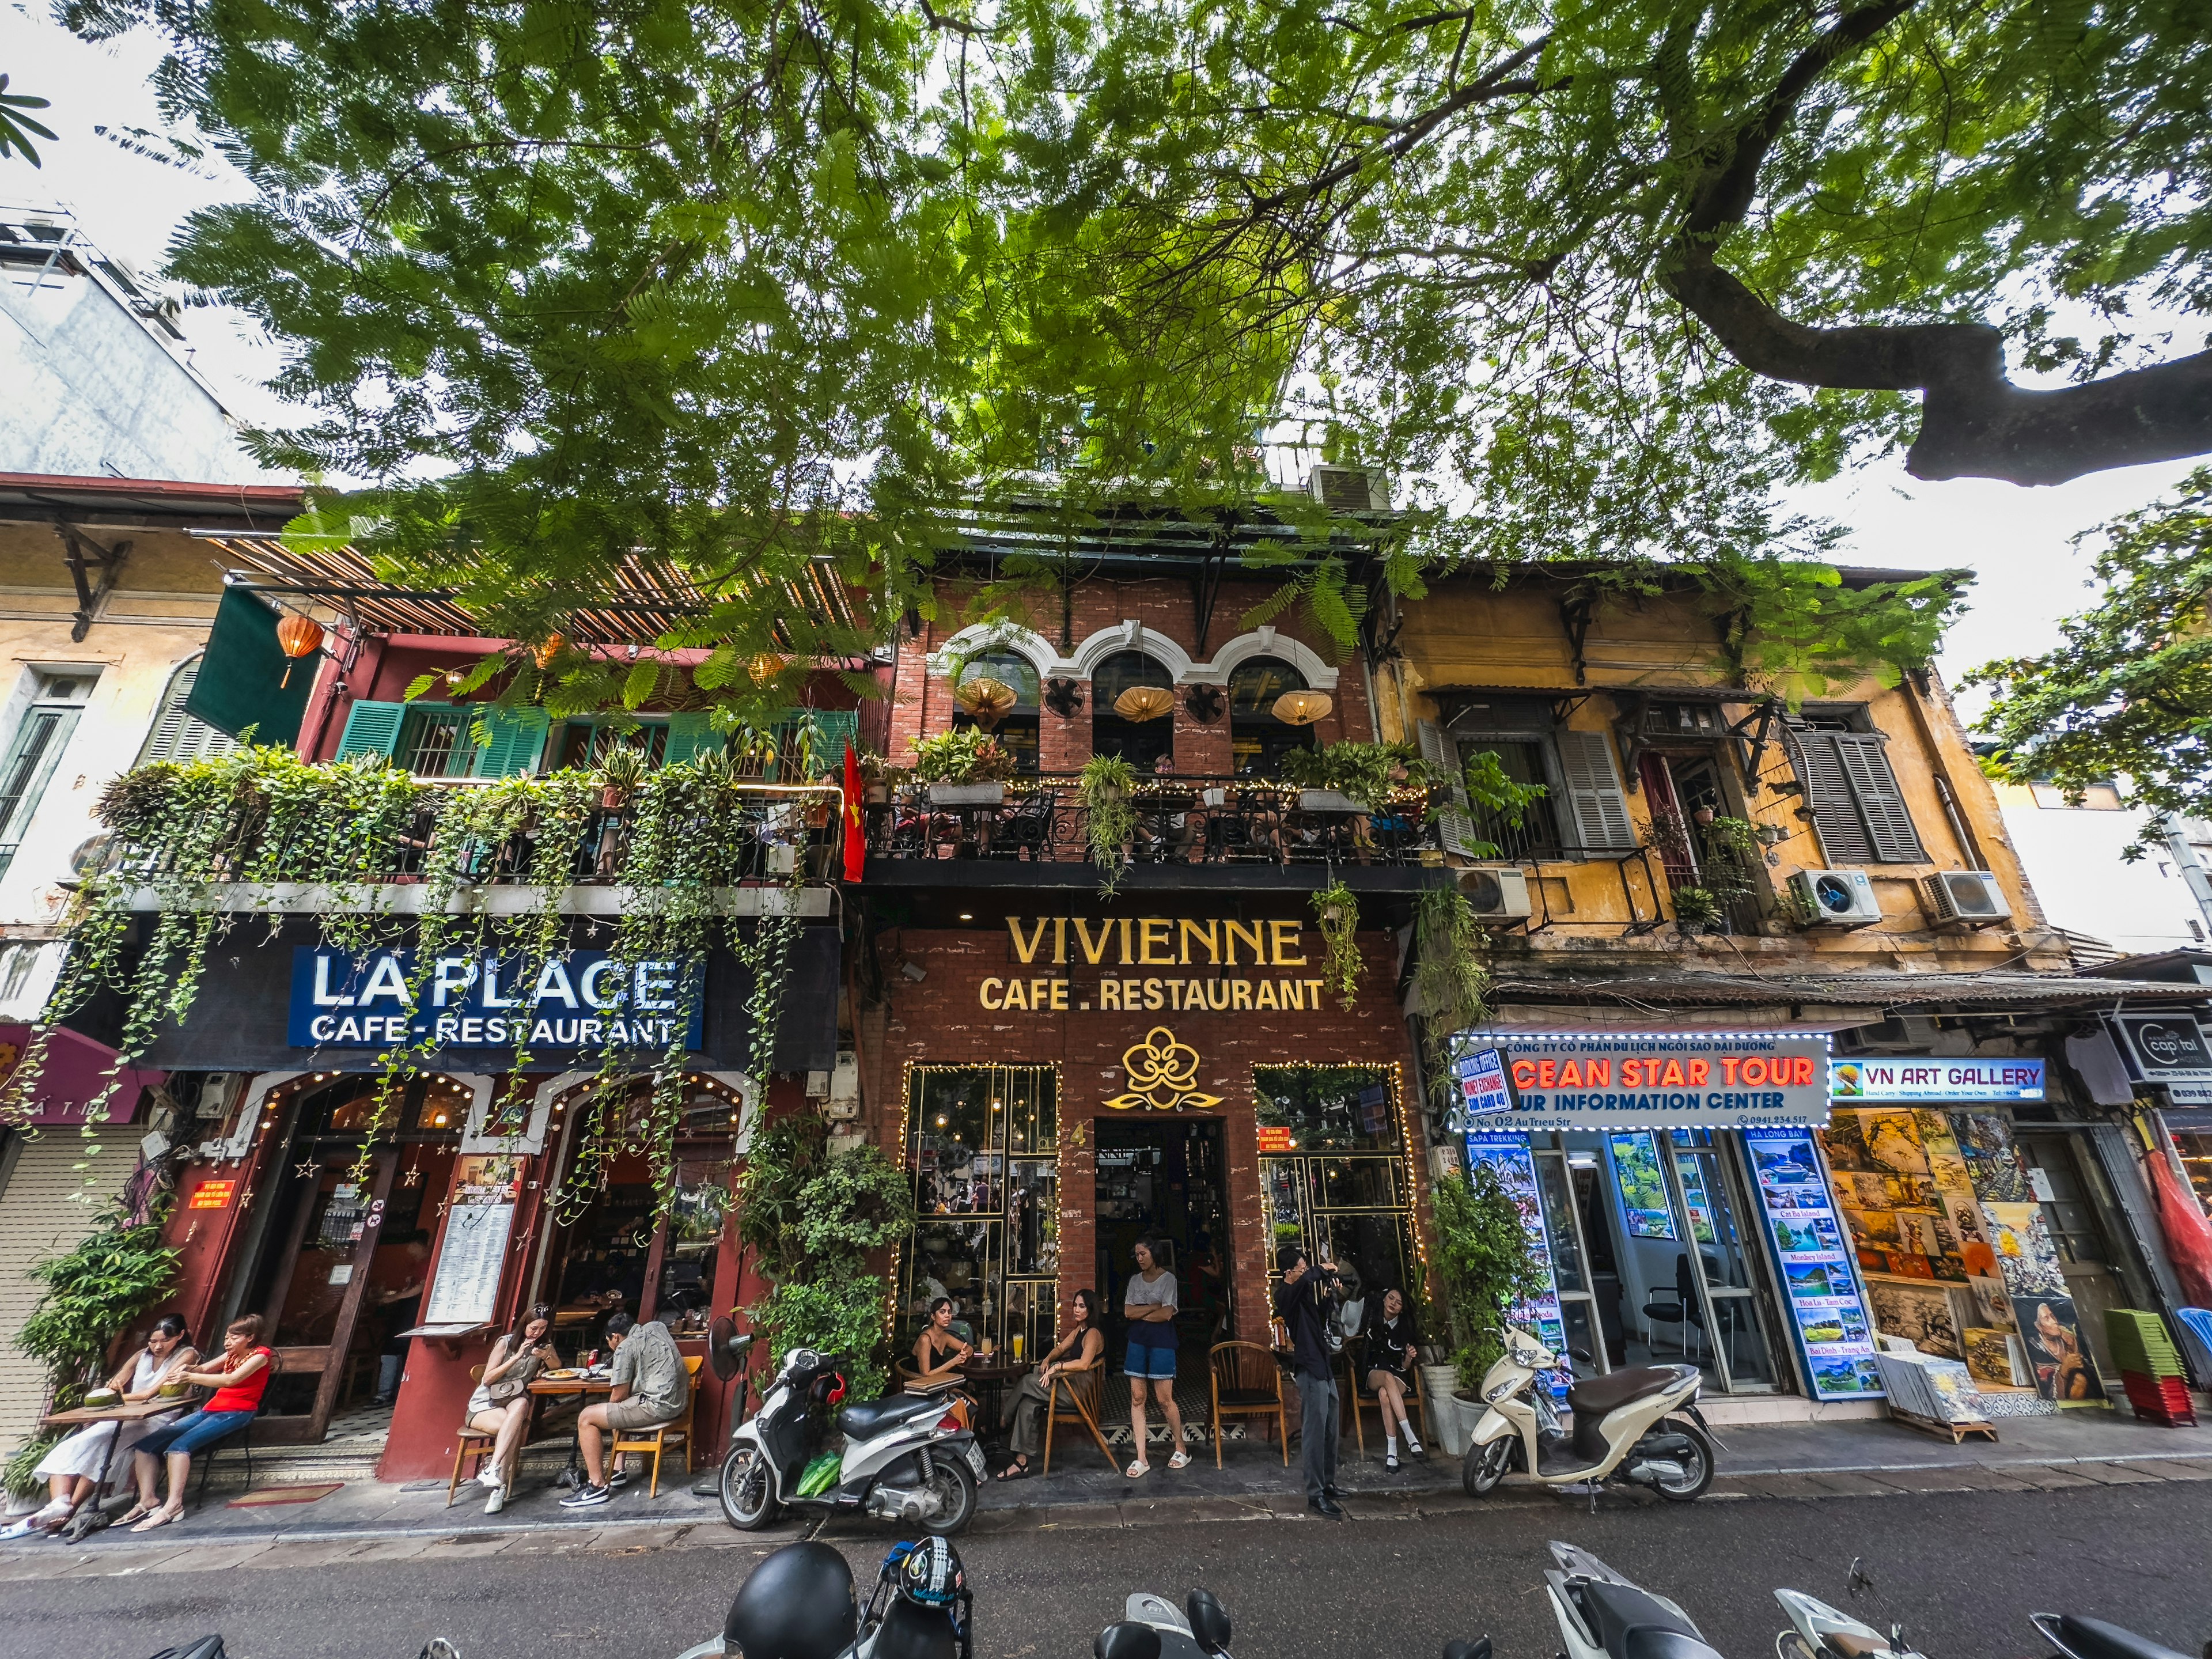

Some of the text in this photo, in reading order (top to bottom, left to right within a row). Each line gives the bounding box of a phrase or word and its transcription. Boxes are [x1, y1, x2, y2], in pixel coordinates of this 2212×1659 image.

[1005, 916, 1307, 965] VIVIENNE
[313, 956, 677, 1010] LA PLACE
[980, 977, 1069, 1010] CAFE
[1100, 978, 1324, 1011] RESTAURANT
[310, 1015, 407, 1041] CAFE
[436, 1016, 676, 1044] RESTAURANT
[1506, 1041, 1540, 1052] CÔNG
[1543, 1043, 1558, 1052] TY
[1613, 1043, 1628, 1051] DU
[1631, 1043, 1656, 1054] LỊCH
[1658, 1040, 1687, 1051] NGÔI
[1690, 1043, 1711, 1051] SAO
[1714, 1042, 1732, 1054] ĐẠI
[1479, 1052, 1498, 1071] OFFICE
[1510, 1056, 1814, 1089] CEAN STAR TOUR
[1865, 1068, 2041, 1085] VN ART GALLERY
[1468, 1092, 1506, 1111] SIM CARD 4G
[1554, 1093, 1700, 1111] INFORMATION
[1707, 1091, 1785, 1109] CENTER
[1476, 1118, 1493, 1127] No.
[1495, 1116, 1513, 1127] 02
[1514, 1118, 1528, 1126] Au
[1556, 1116, 1571, 1126] Str
[1749, 1115, 1807, 1124] 0941.234.517
[1468, 1134, 1527, 1142] SAPA TREKKING
[1750, 1130, 1803, 1138] HA LONG BAY
[1790, 1252, 1836, 1262] Monkey Island
[1839, 1297, 1853, 1305] Coc
